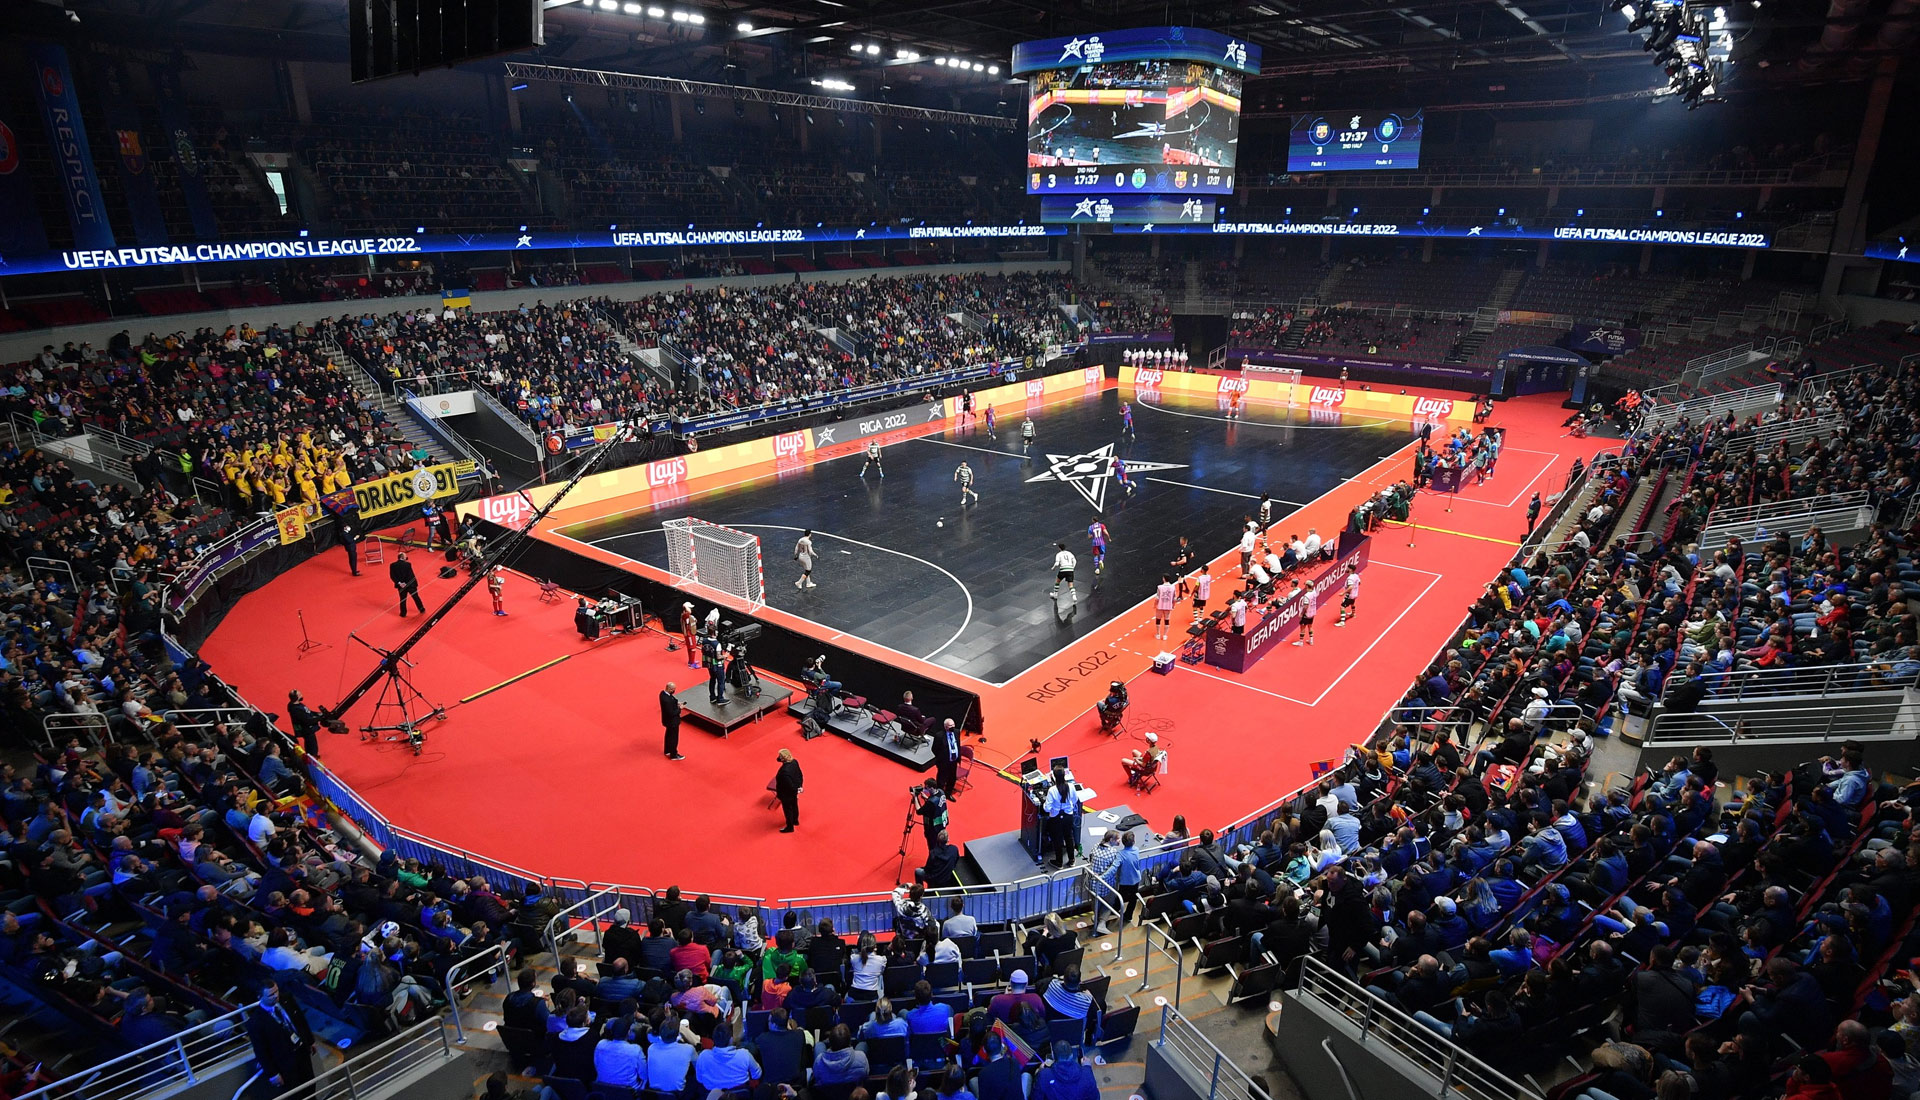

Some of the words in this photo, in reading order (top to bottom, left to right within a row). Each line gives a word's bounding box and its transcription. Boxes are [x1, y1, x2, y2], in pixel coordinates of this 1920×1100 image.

[1340, 132, 1367, 142] 17:37
[1316, 146, 1323, 155] 3
[1382, 144, 1389, 153] 0
[53, 107, 96, 223] RESPECT
[1047, 174, 1056, 188] 3
[1074, 175, 1099, 185] 17:37
[1115, 172, 1125, 187] 0
[1192, 173, 1198, 187] 3
[1226, 175, 1232, 188] 0
[613, 232, 643, 245] UEFA
[643, 231, 686, 245] FUTSAL
[686, 231, 745, 244] CHAMPIONS
[745, 230, 781, 242] LEAGUE
[781, 229, 803, 241] 2022
[909, 227, 927, 238] UEFA
[926, 226, 953, 238] FUTSAL
[952, 226, 999, 237] CHAMPIONS
[998, 226, 1027, 236] LEAGUE
[1027, 225, 1045, 235] 2022
[1212, 223, 1237, 233] UEFA
[1237, 223, 1275, 233] FUTSAL
[1275, 223, 1333, 234] CHAMPIONS
[1333, 224, 1371, 234] LEAGUE
[1372, 224, 1398, 235] 2022
[1553, 227, 1583, 239] UEFA
[1582, 228, 1629, 240] FUTSAL
[1628, 230, 1696, 243] CHAMPIONS
[1695, 231, 1739, 245] LEAGUE
[1737, 233, 1766, 246] 2022
[62, 250, 119, 269] UEFA
[118, 246, 197, 265] FUTSAL
[196, 241, 306, 261] CHAMPIONS
[307, 238, 376, 255] LEAGUE
[377, 237, 416, 252] 2022
[1136, 367, 1163, 387] Lay's
[1310, 386, 1345, 407] Lay's
[1413, 397, 1452, 419] Lay's
[859, 421, 883, 435] RIGA
[885, 413, 908, 428] 2022
[775, 430, 804, 457] Lay's
[650, 457, 686, 485] Lay's
[355, 477, 415, 513] DRACS
[433, 467, 457, 491] 91
[1093, 528, 1102, 538] 17
[1247, 629, 1269, 654] UEFA
[1268, 605, 1299, 637] FUTSAL
[1298, 569, 1337, 617] CMPIONS
[1026, 677, 1079, 704] RIGA
[1068, 650, 1118, 677] 2022
[326, 964, 341, 989] 10
